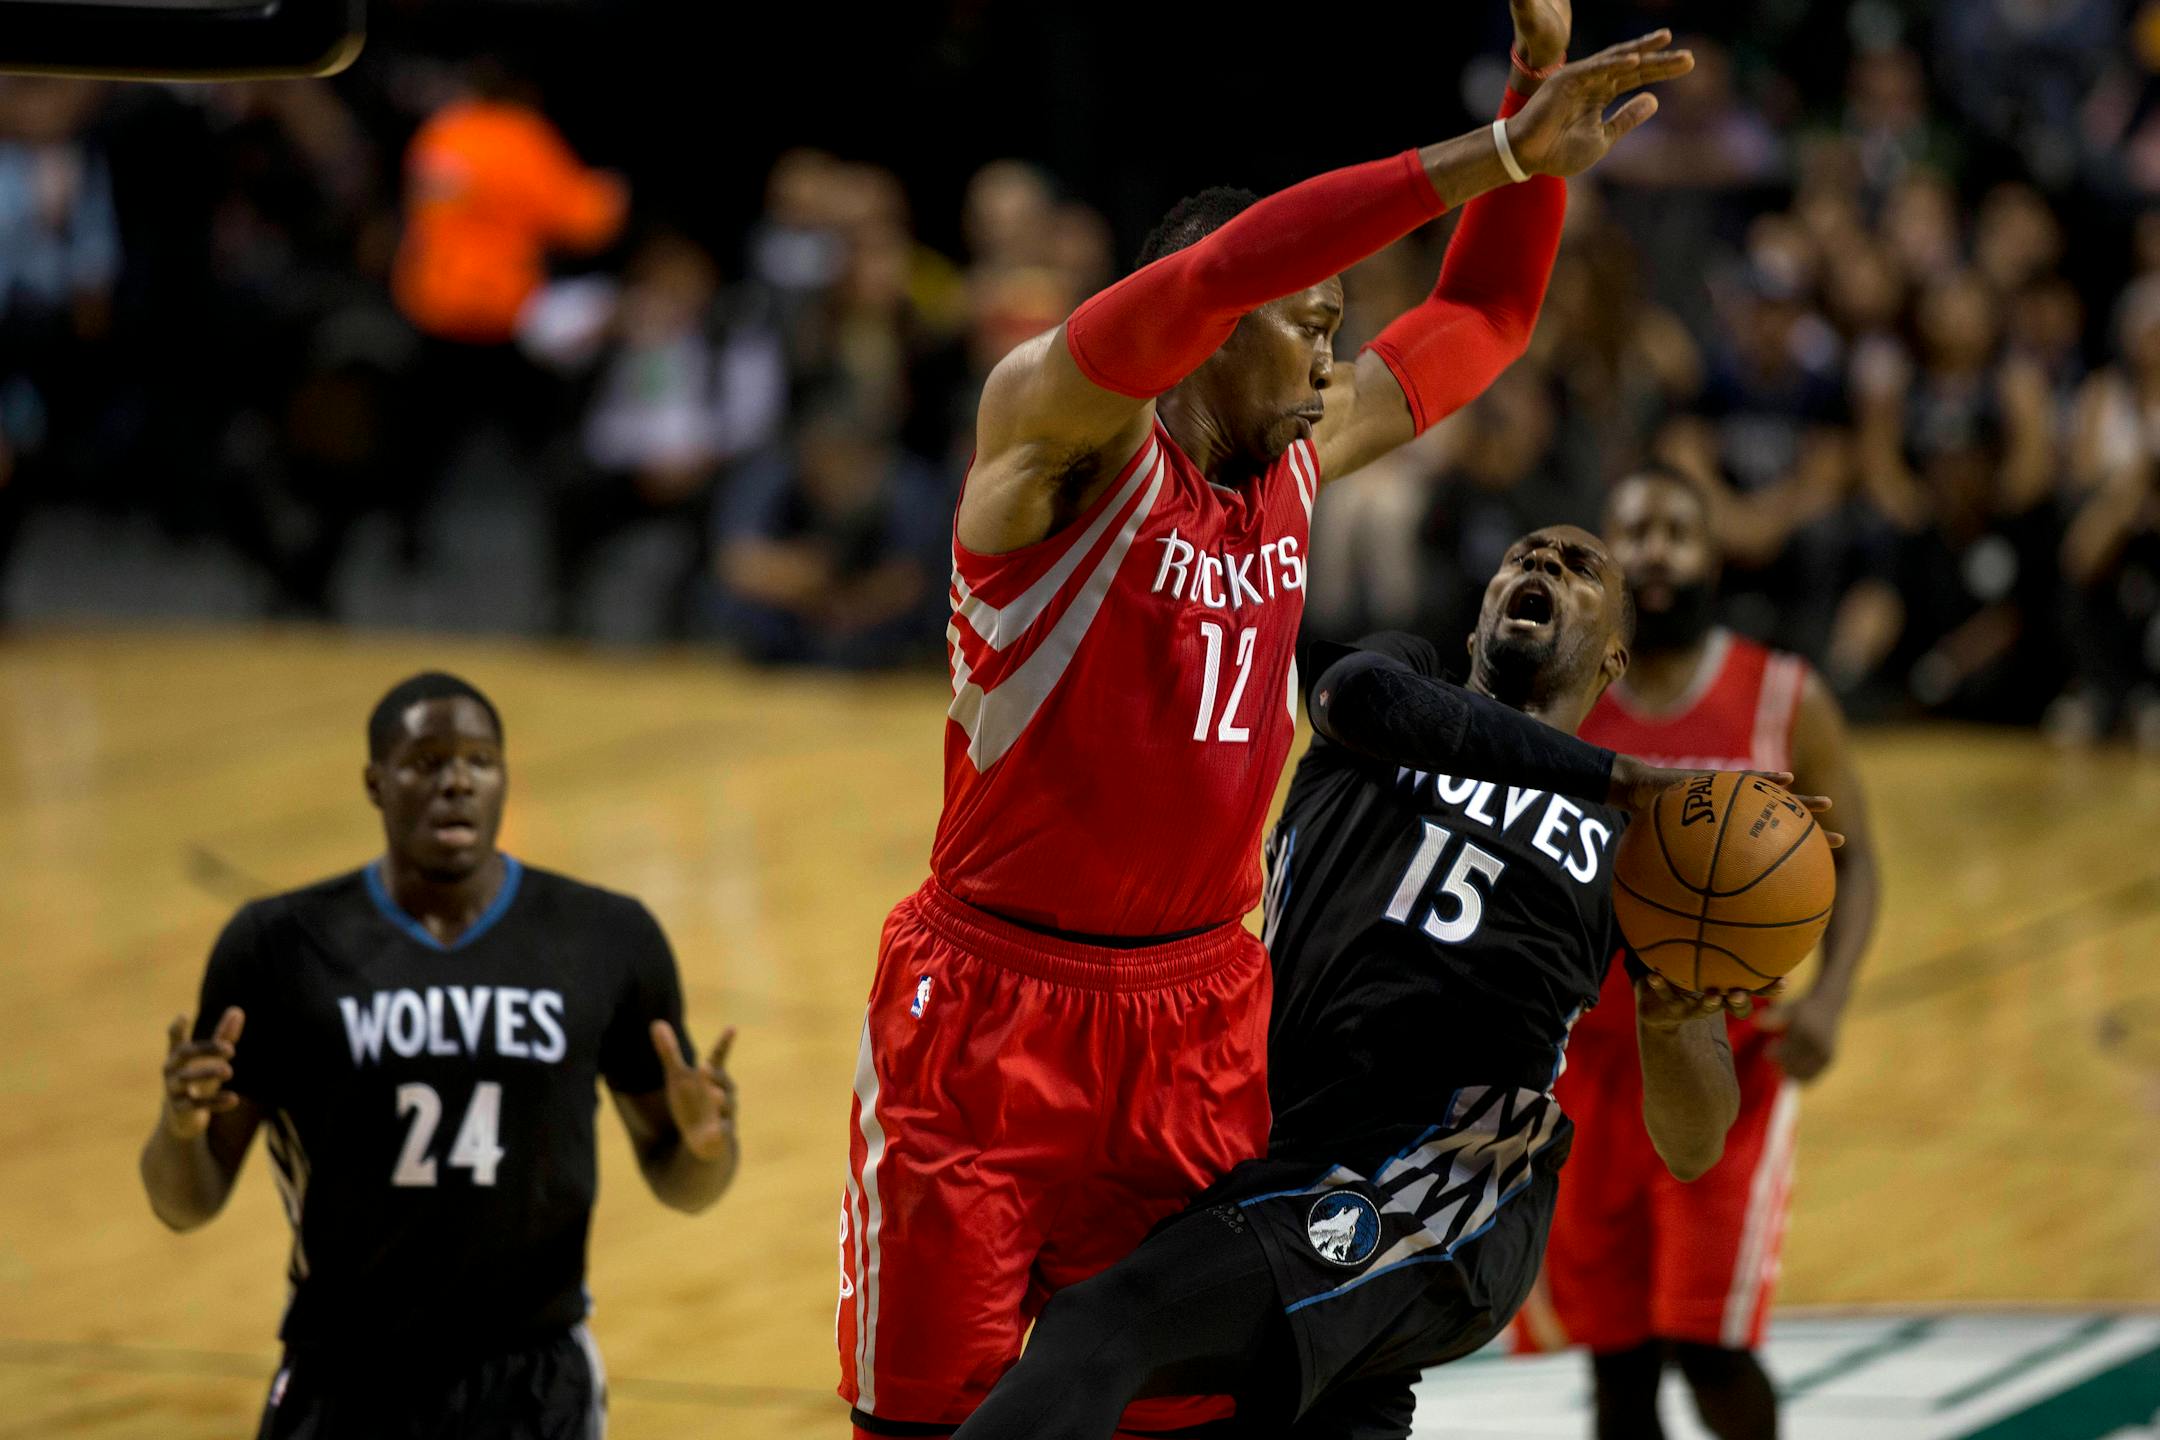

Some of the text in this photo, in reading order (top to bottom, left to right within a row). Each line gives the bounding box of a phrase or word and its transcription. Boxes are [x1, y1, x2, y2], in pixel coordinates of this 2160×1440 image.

[1151, 527, 1302, 611] ROCKTS
[1193, 620, 1257, 742] 12
[1383, 818, 1507, 943] 15
[1396, 765, 1613, 884] OLVES
[338, 985, 567, 1066] WOLVES
[391, 1081, 505, 1187] 24
